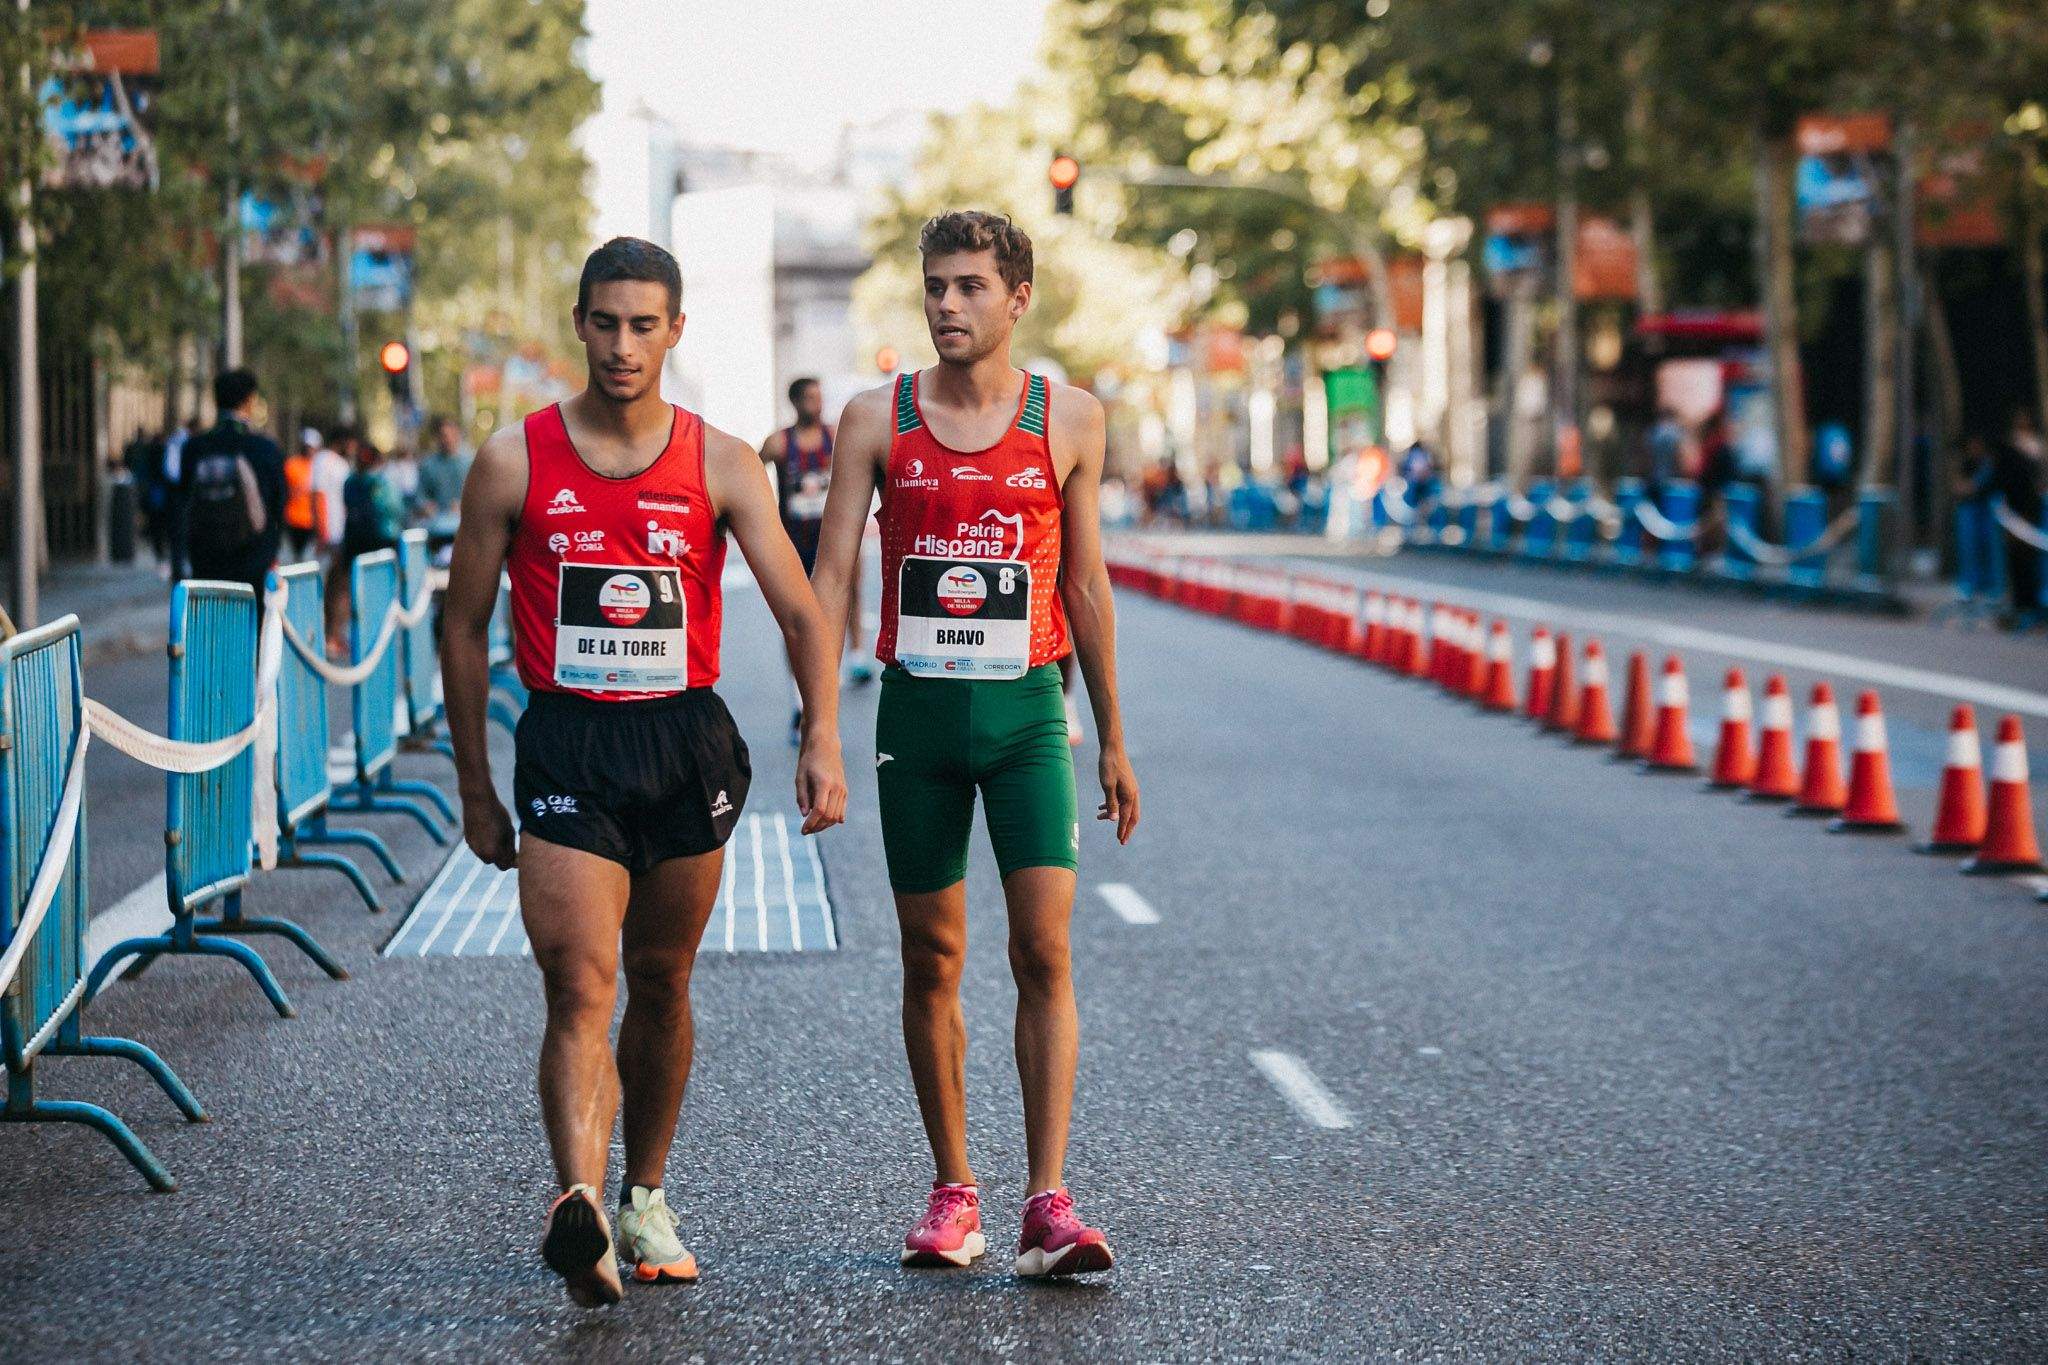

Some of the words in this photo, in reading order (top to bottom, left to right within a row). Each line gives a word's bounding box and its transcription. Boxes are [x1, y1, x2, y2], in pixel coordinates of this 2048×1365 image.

[895, 477, 939, 488] Llamieva
[957, 522, 1004, 538] Patria
[914, 534, 1004, 559] Hispana
[659, 574, 674, 604] 9
[999, 567, 1016, 595] 8
[936, 629, 985, 646] BRAVO
[577, 638, 595, 654] DE
[600, 639, 617, 655] LA
[622, 640, 667, 656] TORRE
[908, 661, 937, 669] MADRID
